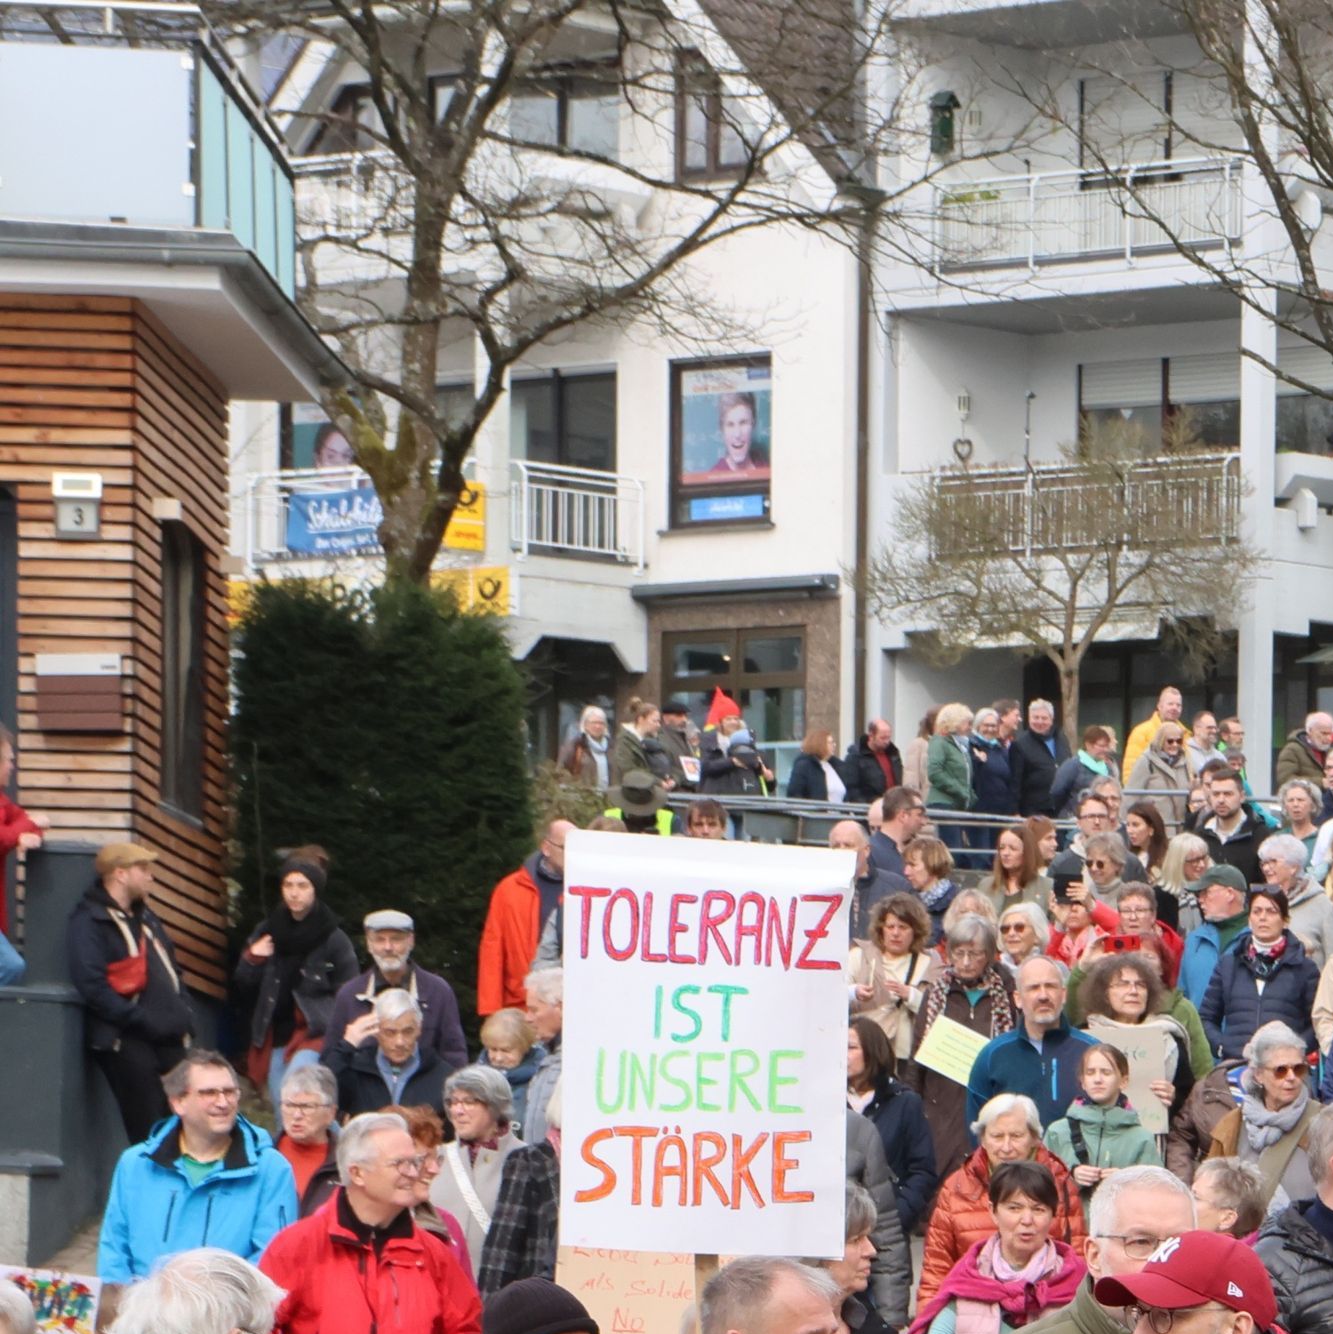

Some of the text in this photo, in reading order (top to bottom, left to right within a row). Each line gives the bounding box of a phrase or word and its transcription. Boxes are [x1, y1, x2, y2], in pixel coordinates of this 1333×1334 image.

[73, 507, 84, 526] 3
[568, 886, 843, 970] TOLERANZ
[655, 984, 748, 1043] IST
[596, 1049, 804, 1114] UNSERE
[575, 1126, 815, 1209] STÄRKE
